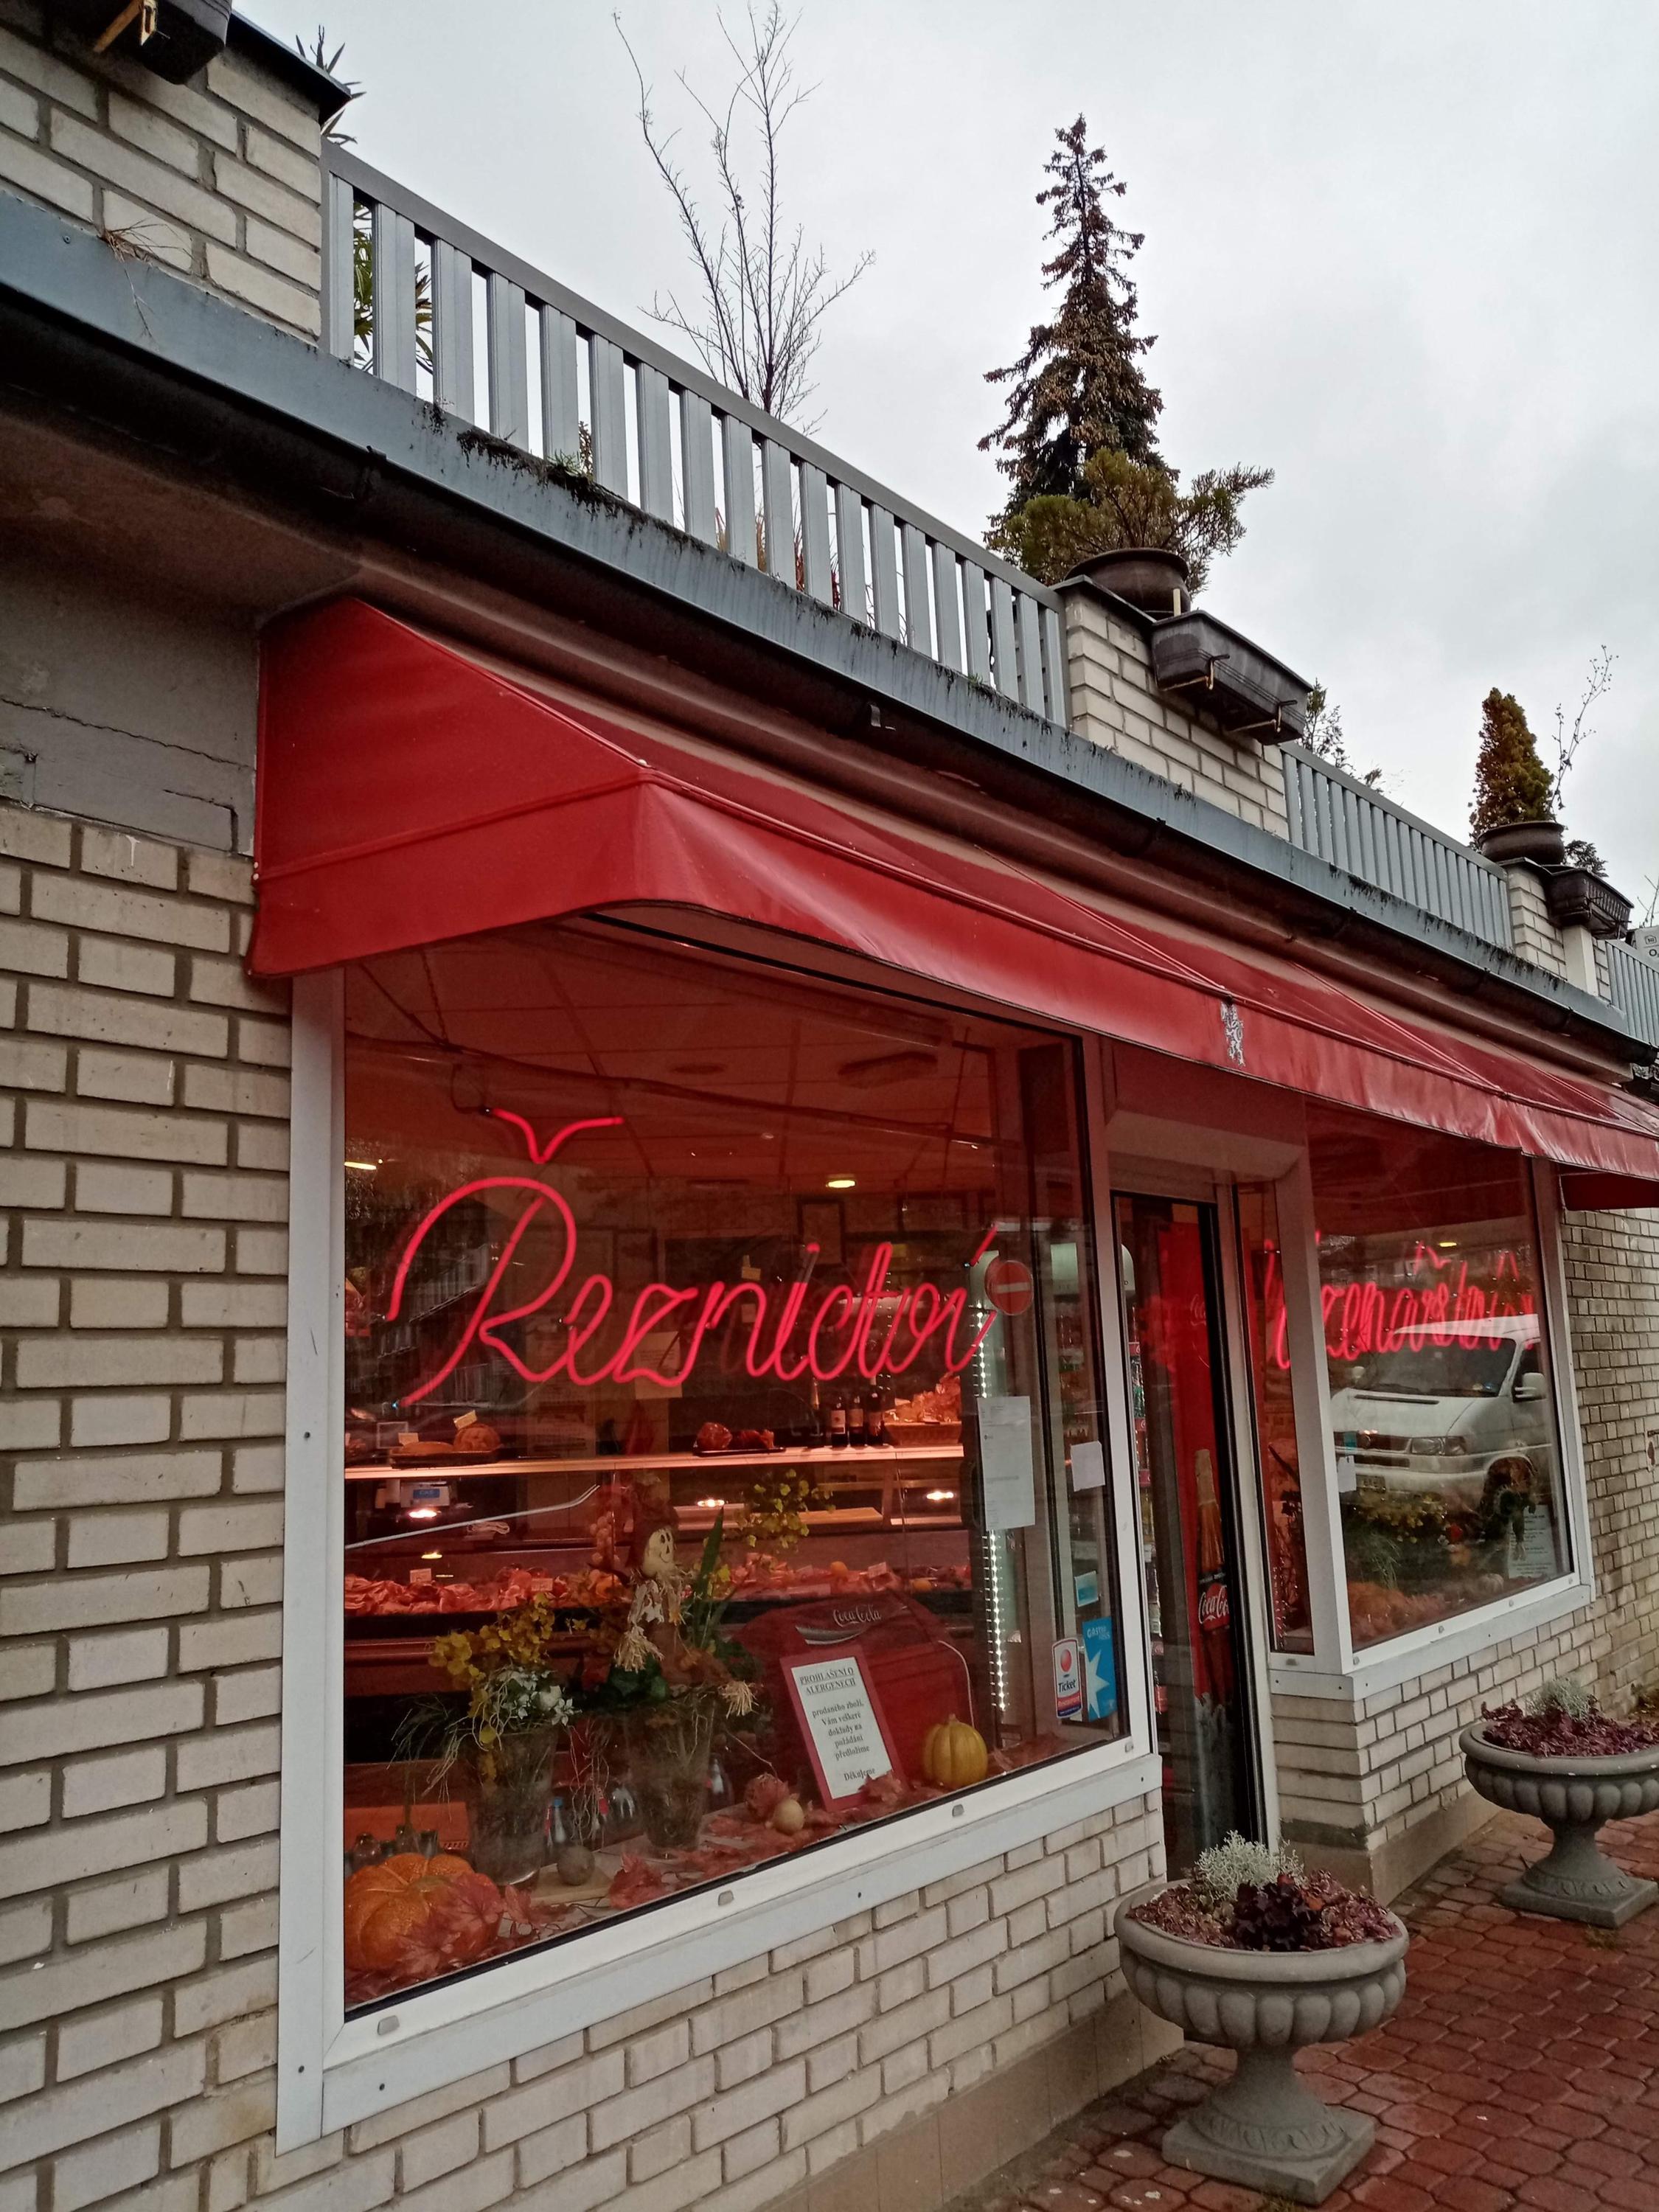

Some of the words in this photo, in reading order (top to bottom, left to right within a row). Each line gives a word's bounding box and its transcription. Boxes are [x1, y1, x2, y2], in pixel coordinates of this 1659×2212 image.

[387, 1107, 998, 1408] Řeznictví
[806, 1677, 856, 1695] ALERGENECH
[1058, 1679, 1077, 1693] Ticket
[812, 1704, 846, 1719] prodaného
[821, 1717, 838, 1726] Vám
[839, 1711, 861, 1723] veškeré
[828, 1725, 853, 1737] doklady
